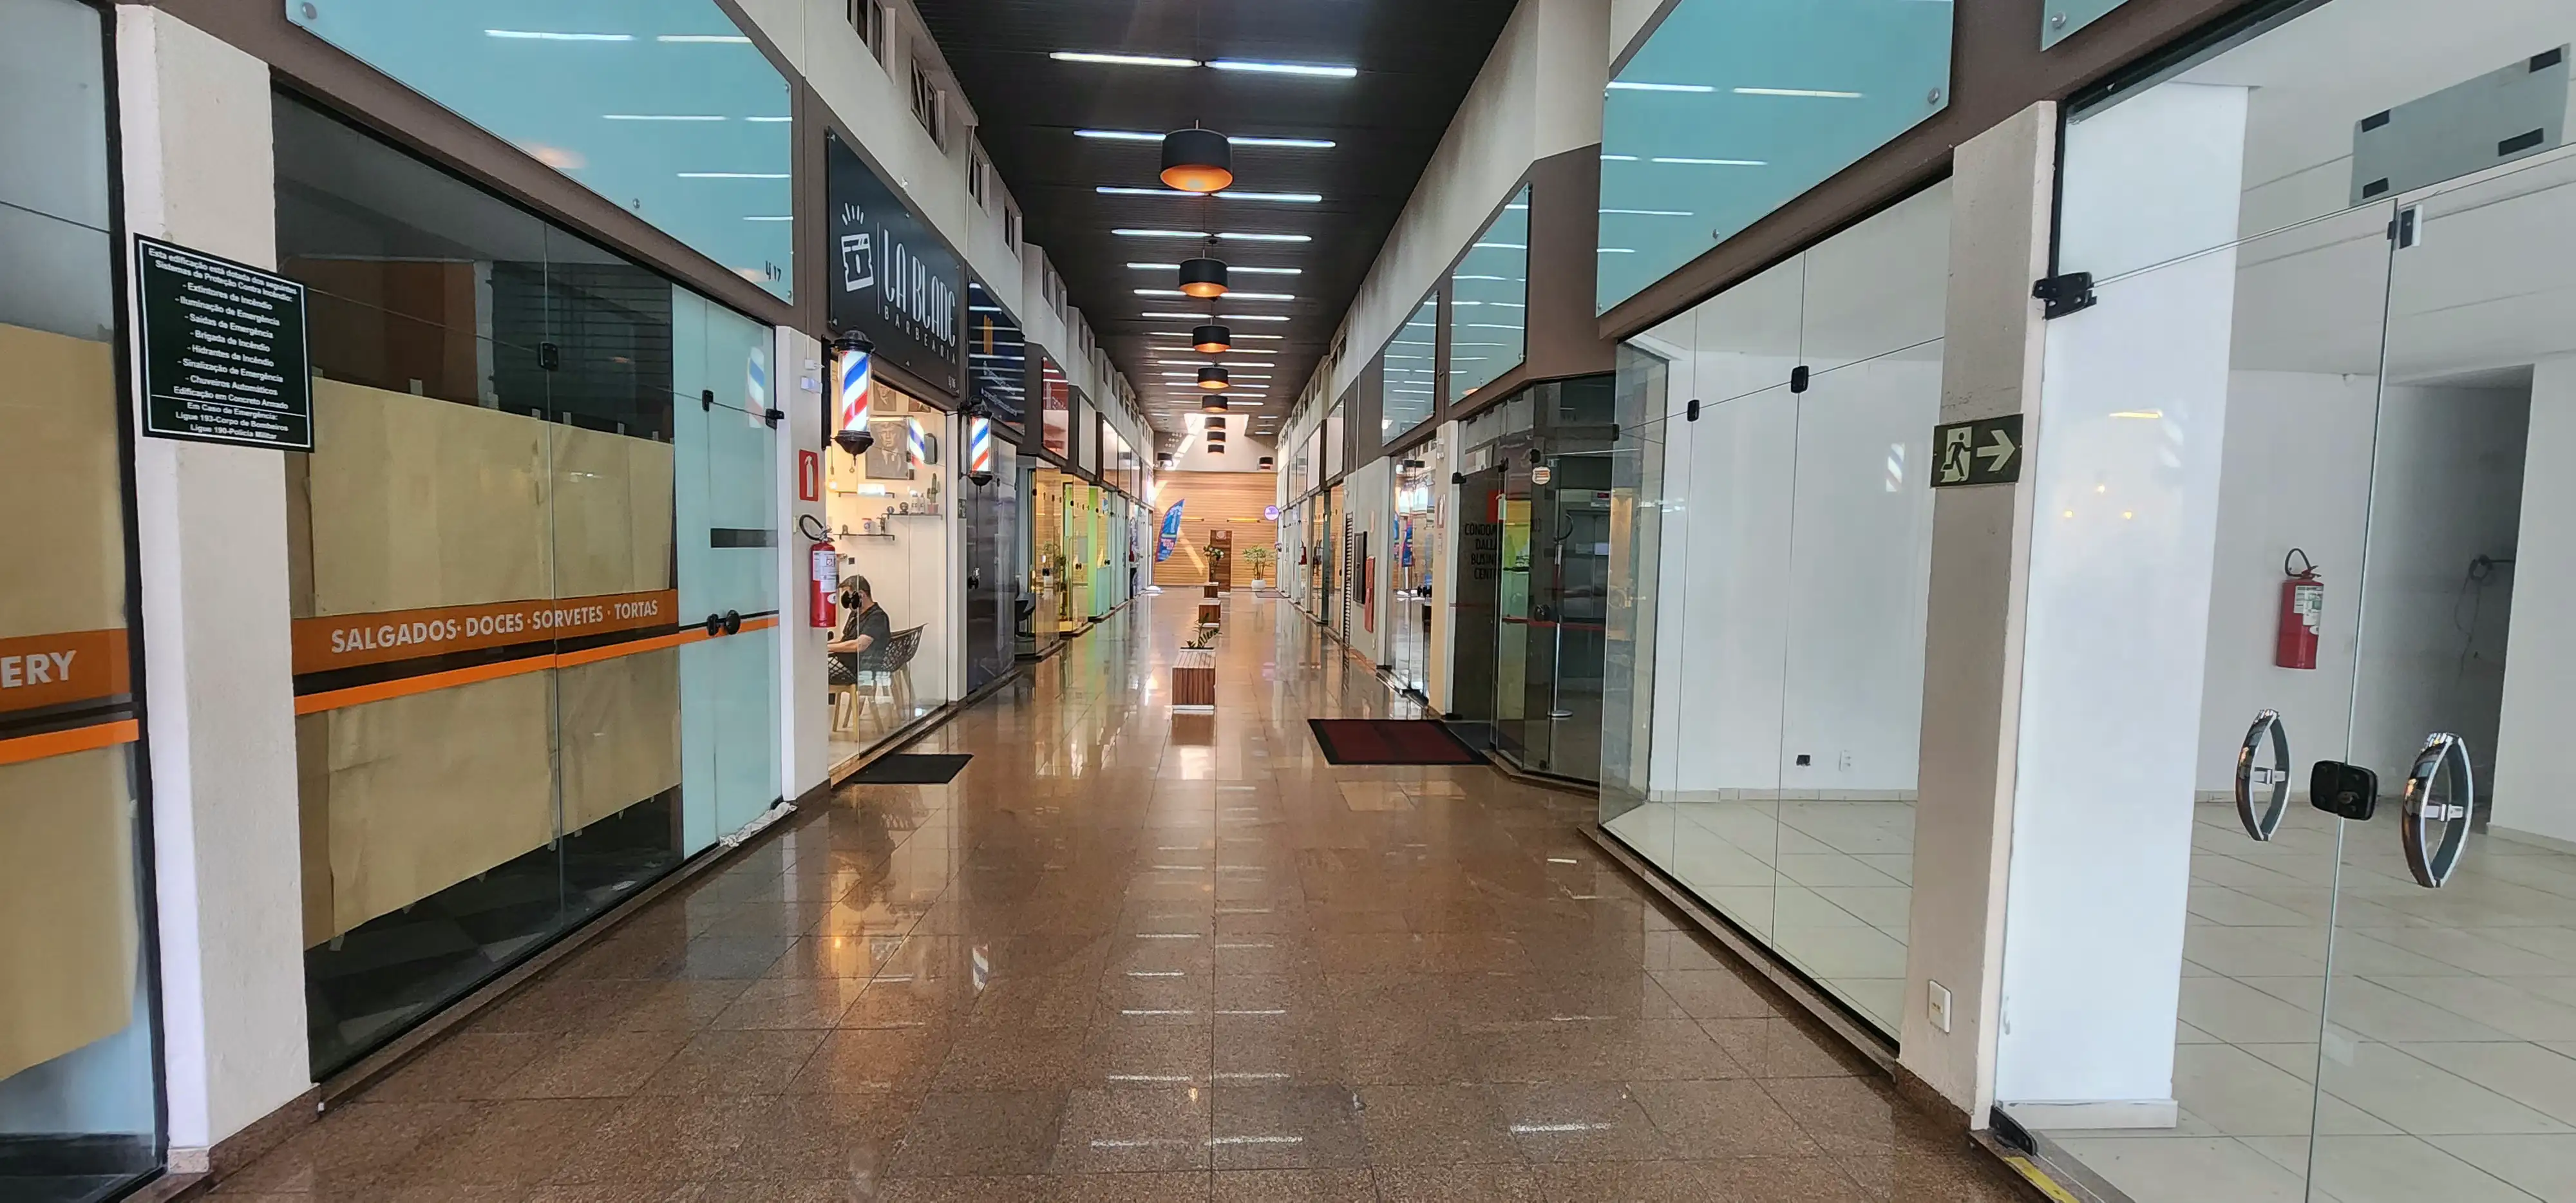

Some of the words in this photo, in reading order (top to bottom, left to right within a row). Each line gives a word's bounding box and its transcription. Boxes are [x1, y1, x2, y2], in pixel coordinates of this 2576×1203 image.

[149, 247, 167, 260] Esta
[155, 260, 192, 276] Sistemas
[193, 270, 203, 279] de
[204, 272, 237, 287] Proteção
[238, 281, 261, 294] Contra
[884, 228, 907, 314] LA
[912, 255, 956, 347] BLADE
[229, 293, 240, 302] de
[225, 307, 236, 316] de
[218, 320, 229, 329] de
[227, 336, 237, 345] de
[884, 305, 956, 365] BARBEARIA
[231, 352, 241, 361] de
[229, 366, 239, 375] de
[187, 401, 200, 410] Em
[202, 404, 222, 413] Caso
[175, 411, 198, 421] Ligue
[251, 420, 289, 431] Bombeiros
[190, 424, 212, 433] Ligue
[466, 613, 524, 637] DOCES
[614, 599, 658, 620] TORTAS
[1, 650, 77, 688] ERY
